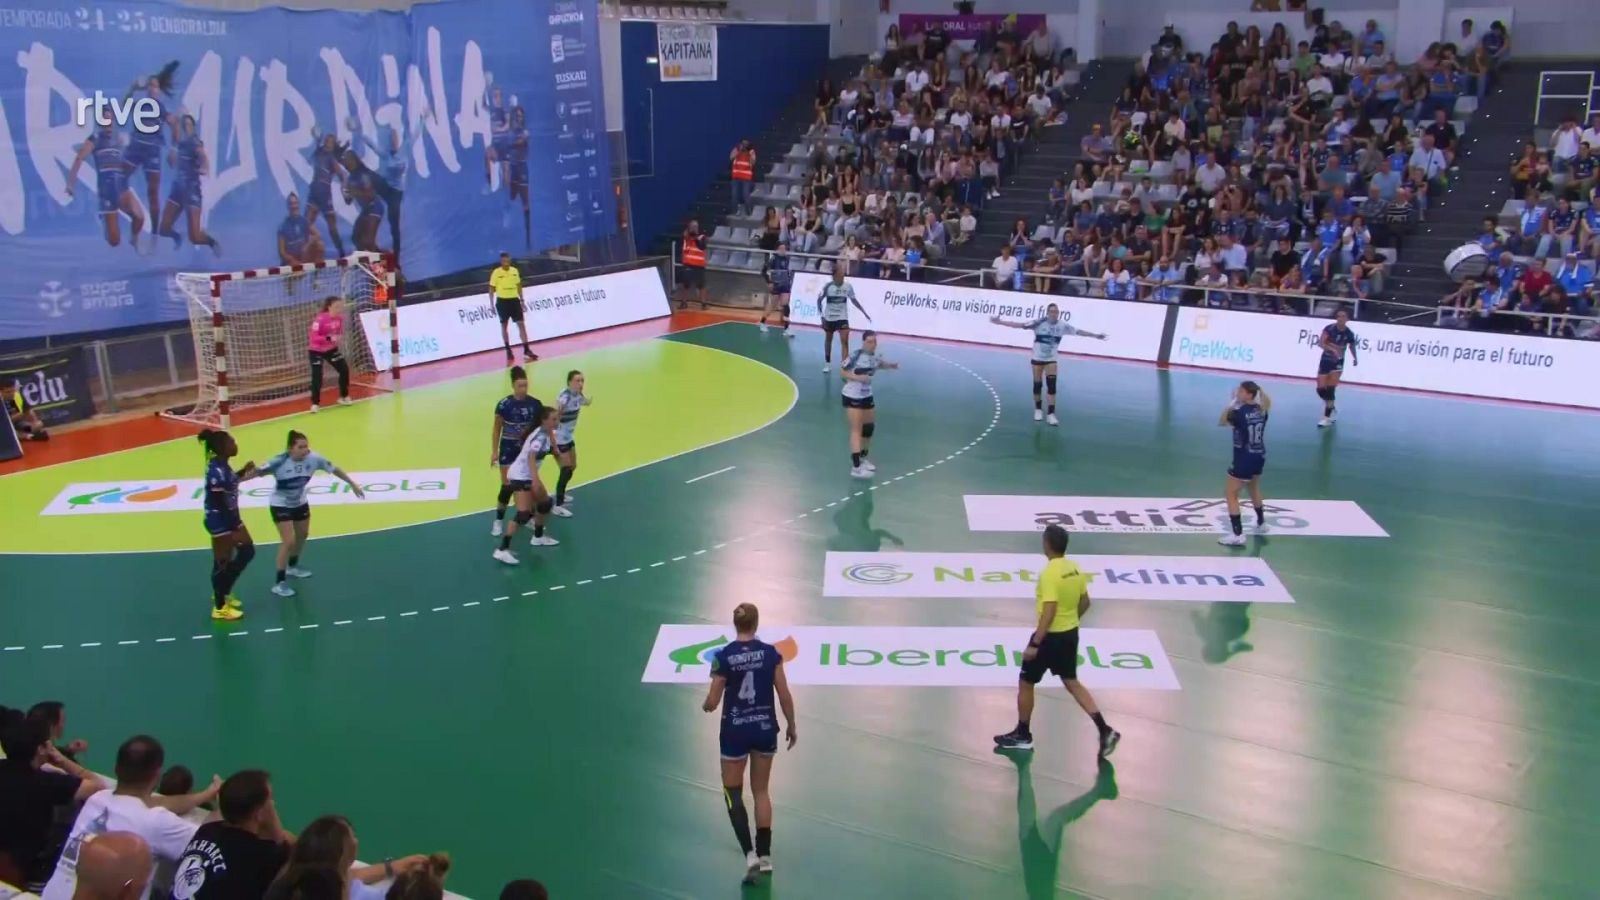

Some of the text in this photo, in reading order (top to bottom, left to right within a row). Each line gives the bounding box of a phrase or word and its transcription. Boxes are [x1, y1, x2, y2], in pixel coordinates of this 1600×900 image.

[660, 42, 713, 61] KAPITAINA
[555, 293, 573, 310] para
[582, 287, 607, 303] futuro
[883, 290, 939, 311] PipeWorks,
[942, 299, 962, 312] una
[965, 299, 996, 315] visión
[998, 303, 1022, 319] para
[1025, 305, 1036, 318] el
[1179, 336, 1254, 362] PipeWorks
[1377, 339, 1402, 354] una
[1407, 339, 1449, 358] visión
[1453, 347, 1486, 363] para
[1490, 347, 1504, 363] el
[1507, 348, 1554, 368] futuro
[738, 670, 756, 705] 4
